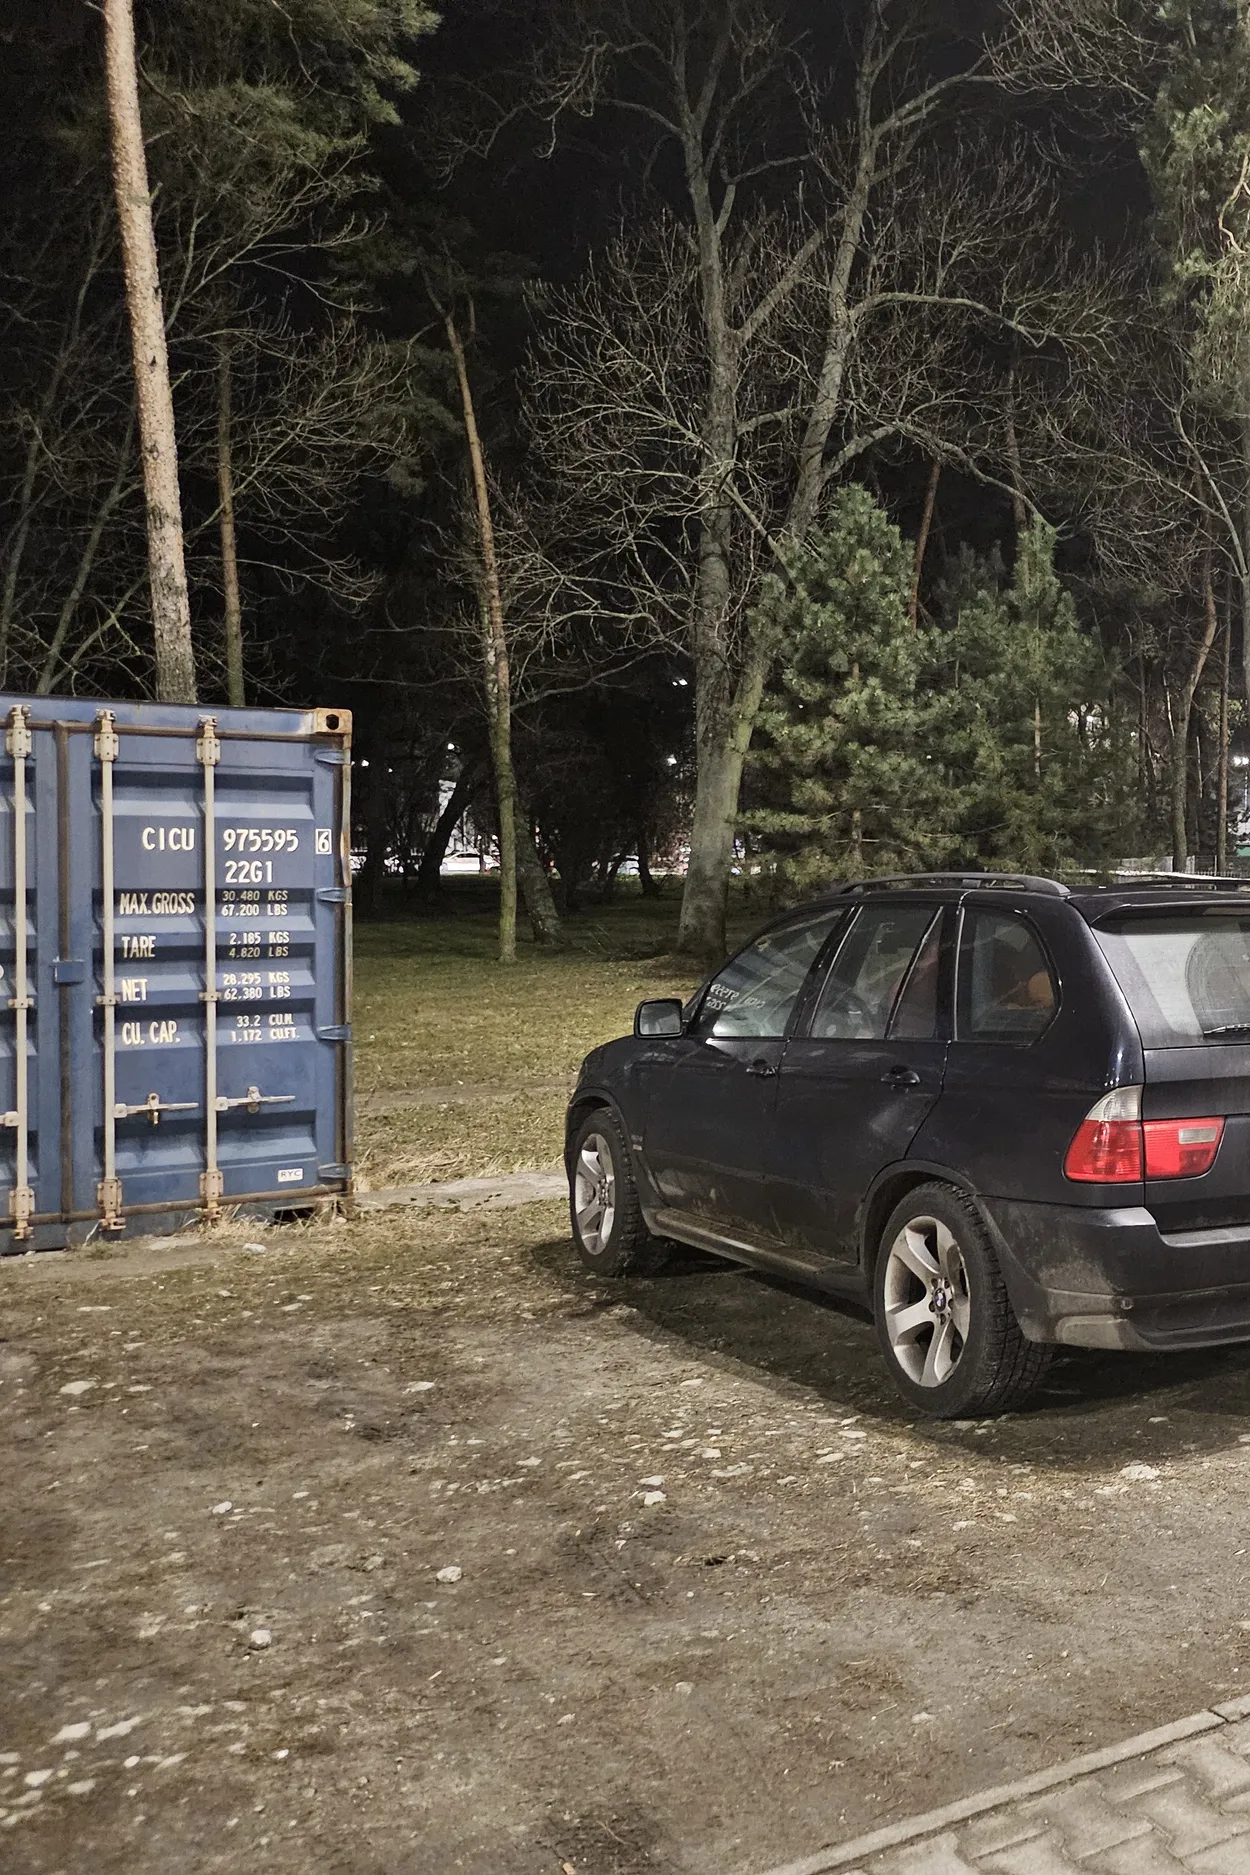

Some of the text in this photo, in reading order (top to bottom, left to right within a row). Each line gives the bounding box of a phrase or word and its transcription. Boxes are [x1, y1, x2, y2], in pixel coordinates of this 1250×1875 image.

[142, 827, 330, 852] CICU 975595 6
[225, 860, 273, 884] 22G1
[268, 890, 288, 901] KGS
[119, 892, 195, 915] MAX.GROSS
[267, 904, 288, 916] LBS
[268, 931, 290, 944] KGS
[121, 935, 157, 959] TARE
[268, 946, 289, 957] LBS
[268, 971, 290, 984] KGS
[121, 978, 148, 1002] NET
[269, 985, 291, 999] LBS
[236, 1014, 261, 1028] 33.2
[122, 1020, 181, 1045] CU. CAP.
